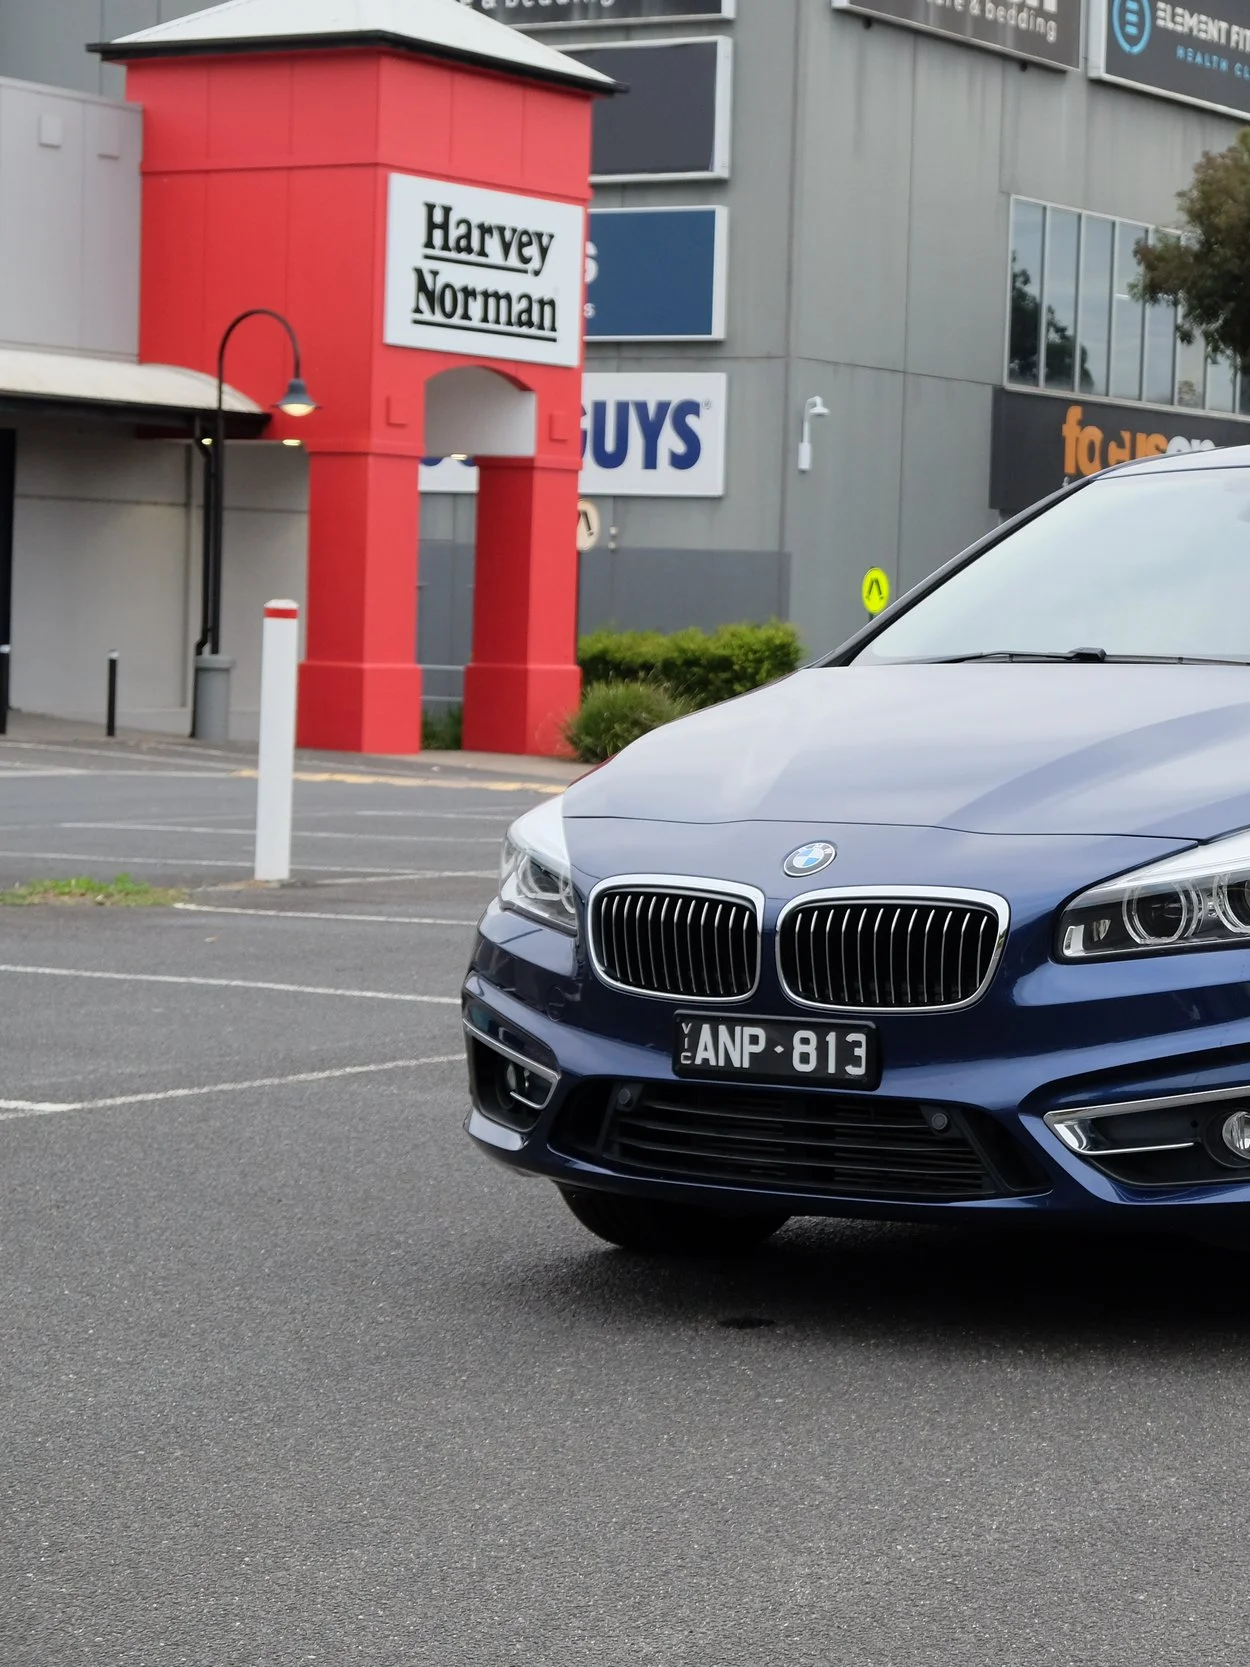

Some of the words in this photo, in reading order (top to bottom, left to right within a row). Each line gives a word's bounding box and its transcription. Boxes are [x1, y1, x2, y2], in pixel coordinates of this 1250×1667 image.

[985, 0, 1057, 43] bedding
[1156, 1, 1229, 46] ELEMENT
[1176, 45, 1228, 73] HEALTH
[423, 201, 555, 277] Harvey
[412, 266, 557, 332] Norman
[680, 1022, 693, 1065] VIC
[694, 1023, 766, 1069] ANP
[792, 1029, 867, 1076] 813
